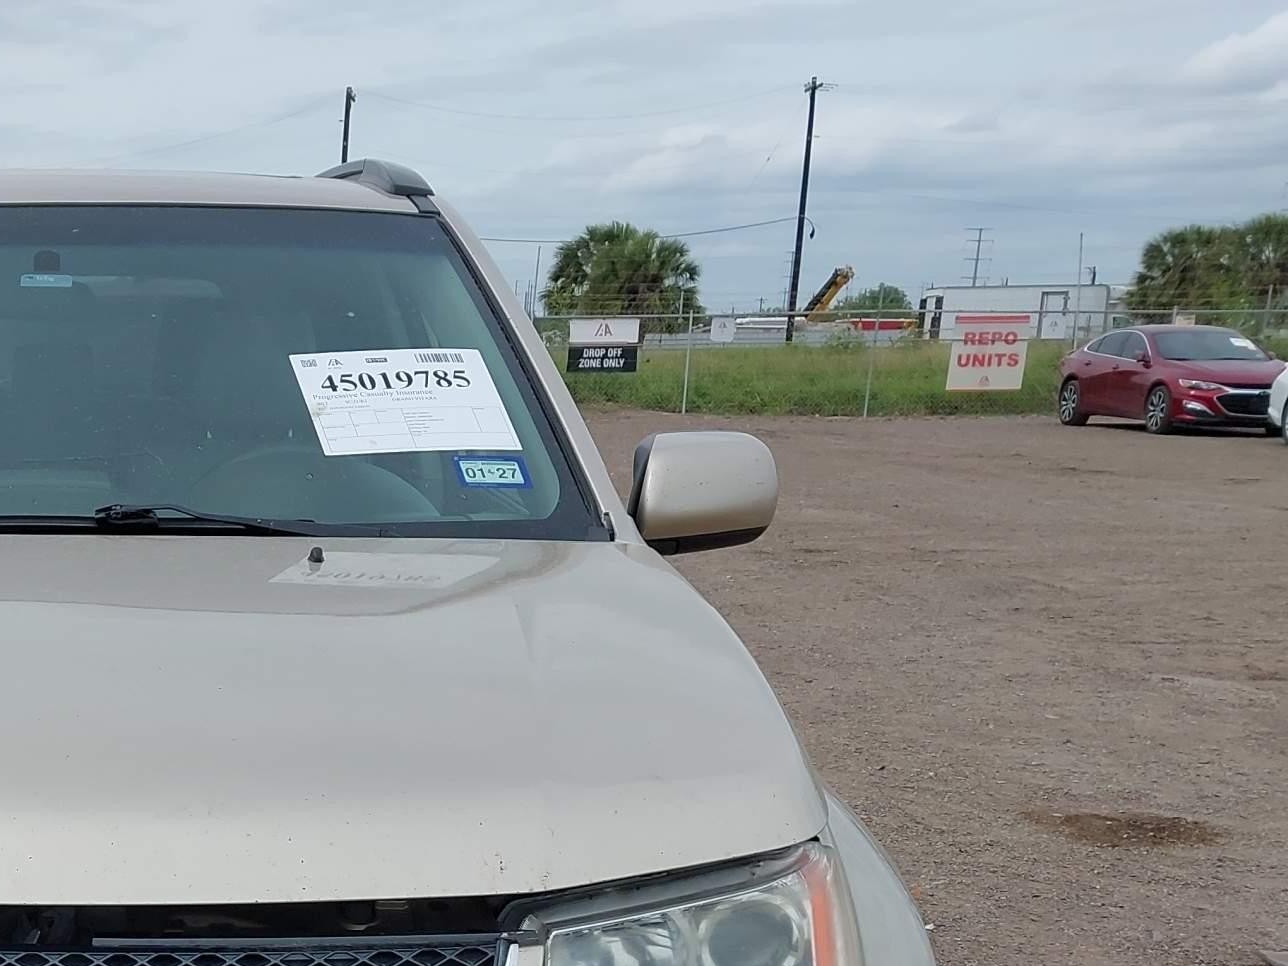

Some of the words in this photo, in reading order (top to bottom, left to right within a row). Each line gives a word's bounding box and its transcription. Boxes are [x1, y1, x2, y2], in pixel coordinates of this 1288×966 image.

[963, 331, 1018, 346] REPO
[583, 348, 606, 358] DROP
[607, 347, 623, 358] OFF
[578, 358, 602, 368] ZONE
[603, 358, 625, 368] ONLY
[957, 353, 1019, 368] UNITS
[321, 370, 471, 392] 45019785
[312, 393, 358, 401] Progressive
[465, 467, 486, 479] 01
[496, 467, 517, 480] 27
